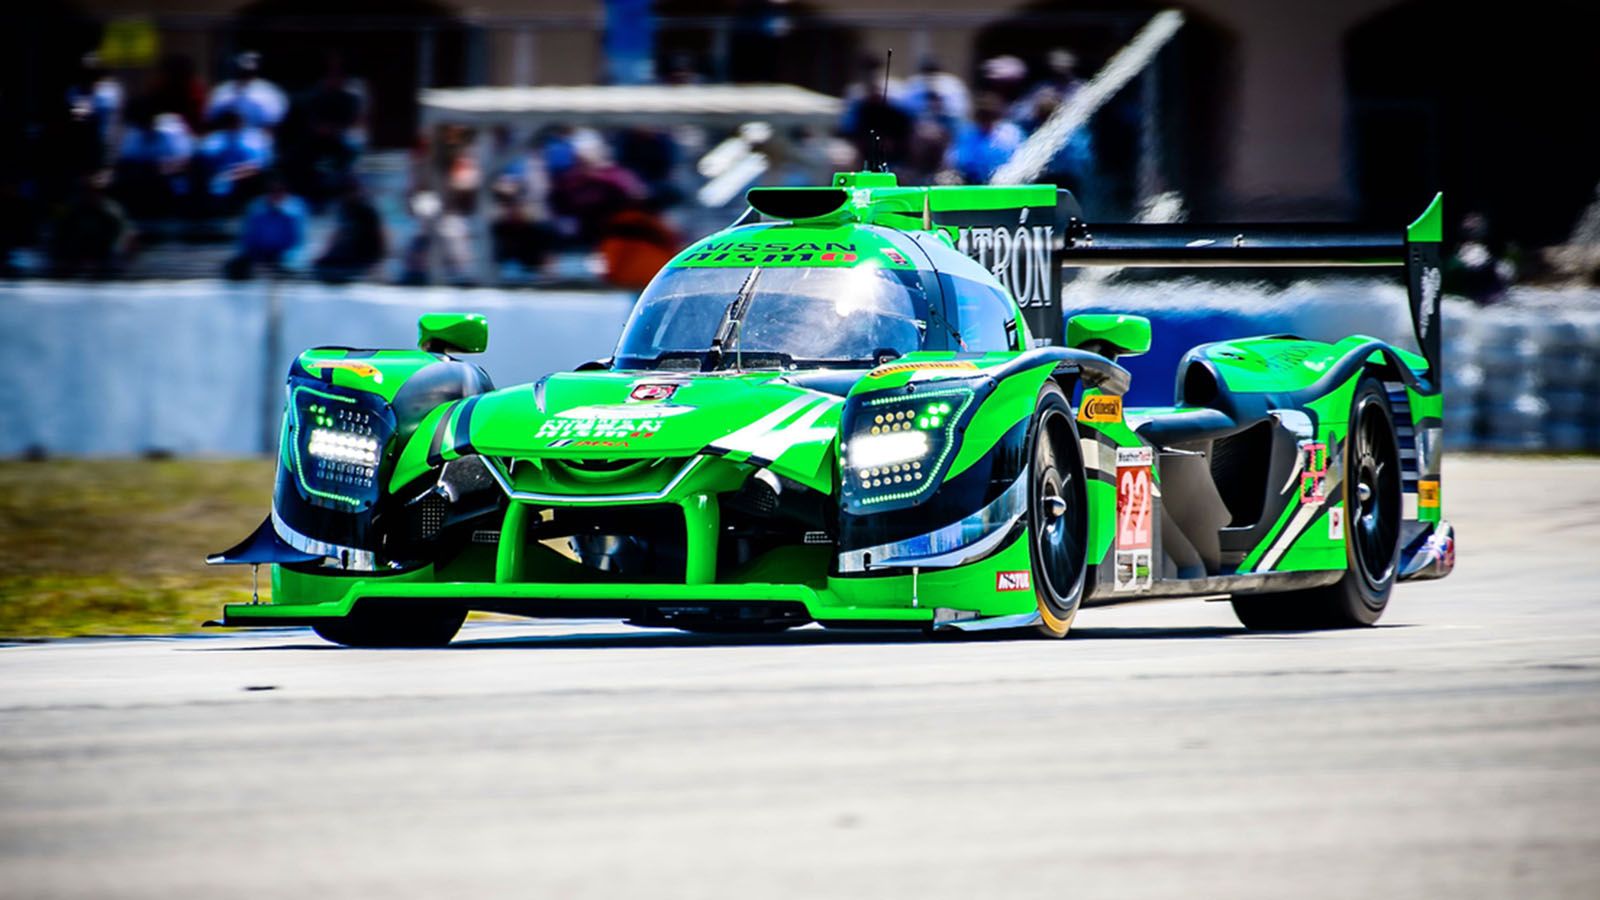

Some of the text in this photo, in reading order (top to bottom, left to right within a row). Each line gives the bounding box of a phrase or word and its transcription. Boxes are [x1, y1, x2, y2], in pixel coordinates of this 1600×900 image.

[698, 242, 856, 252] NISSAN
[539, 423, 662, 432] NISSAN
[1120, 470, 1149, 546] 22
[998, 572, 1030, 590] MOTUL
